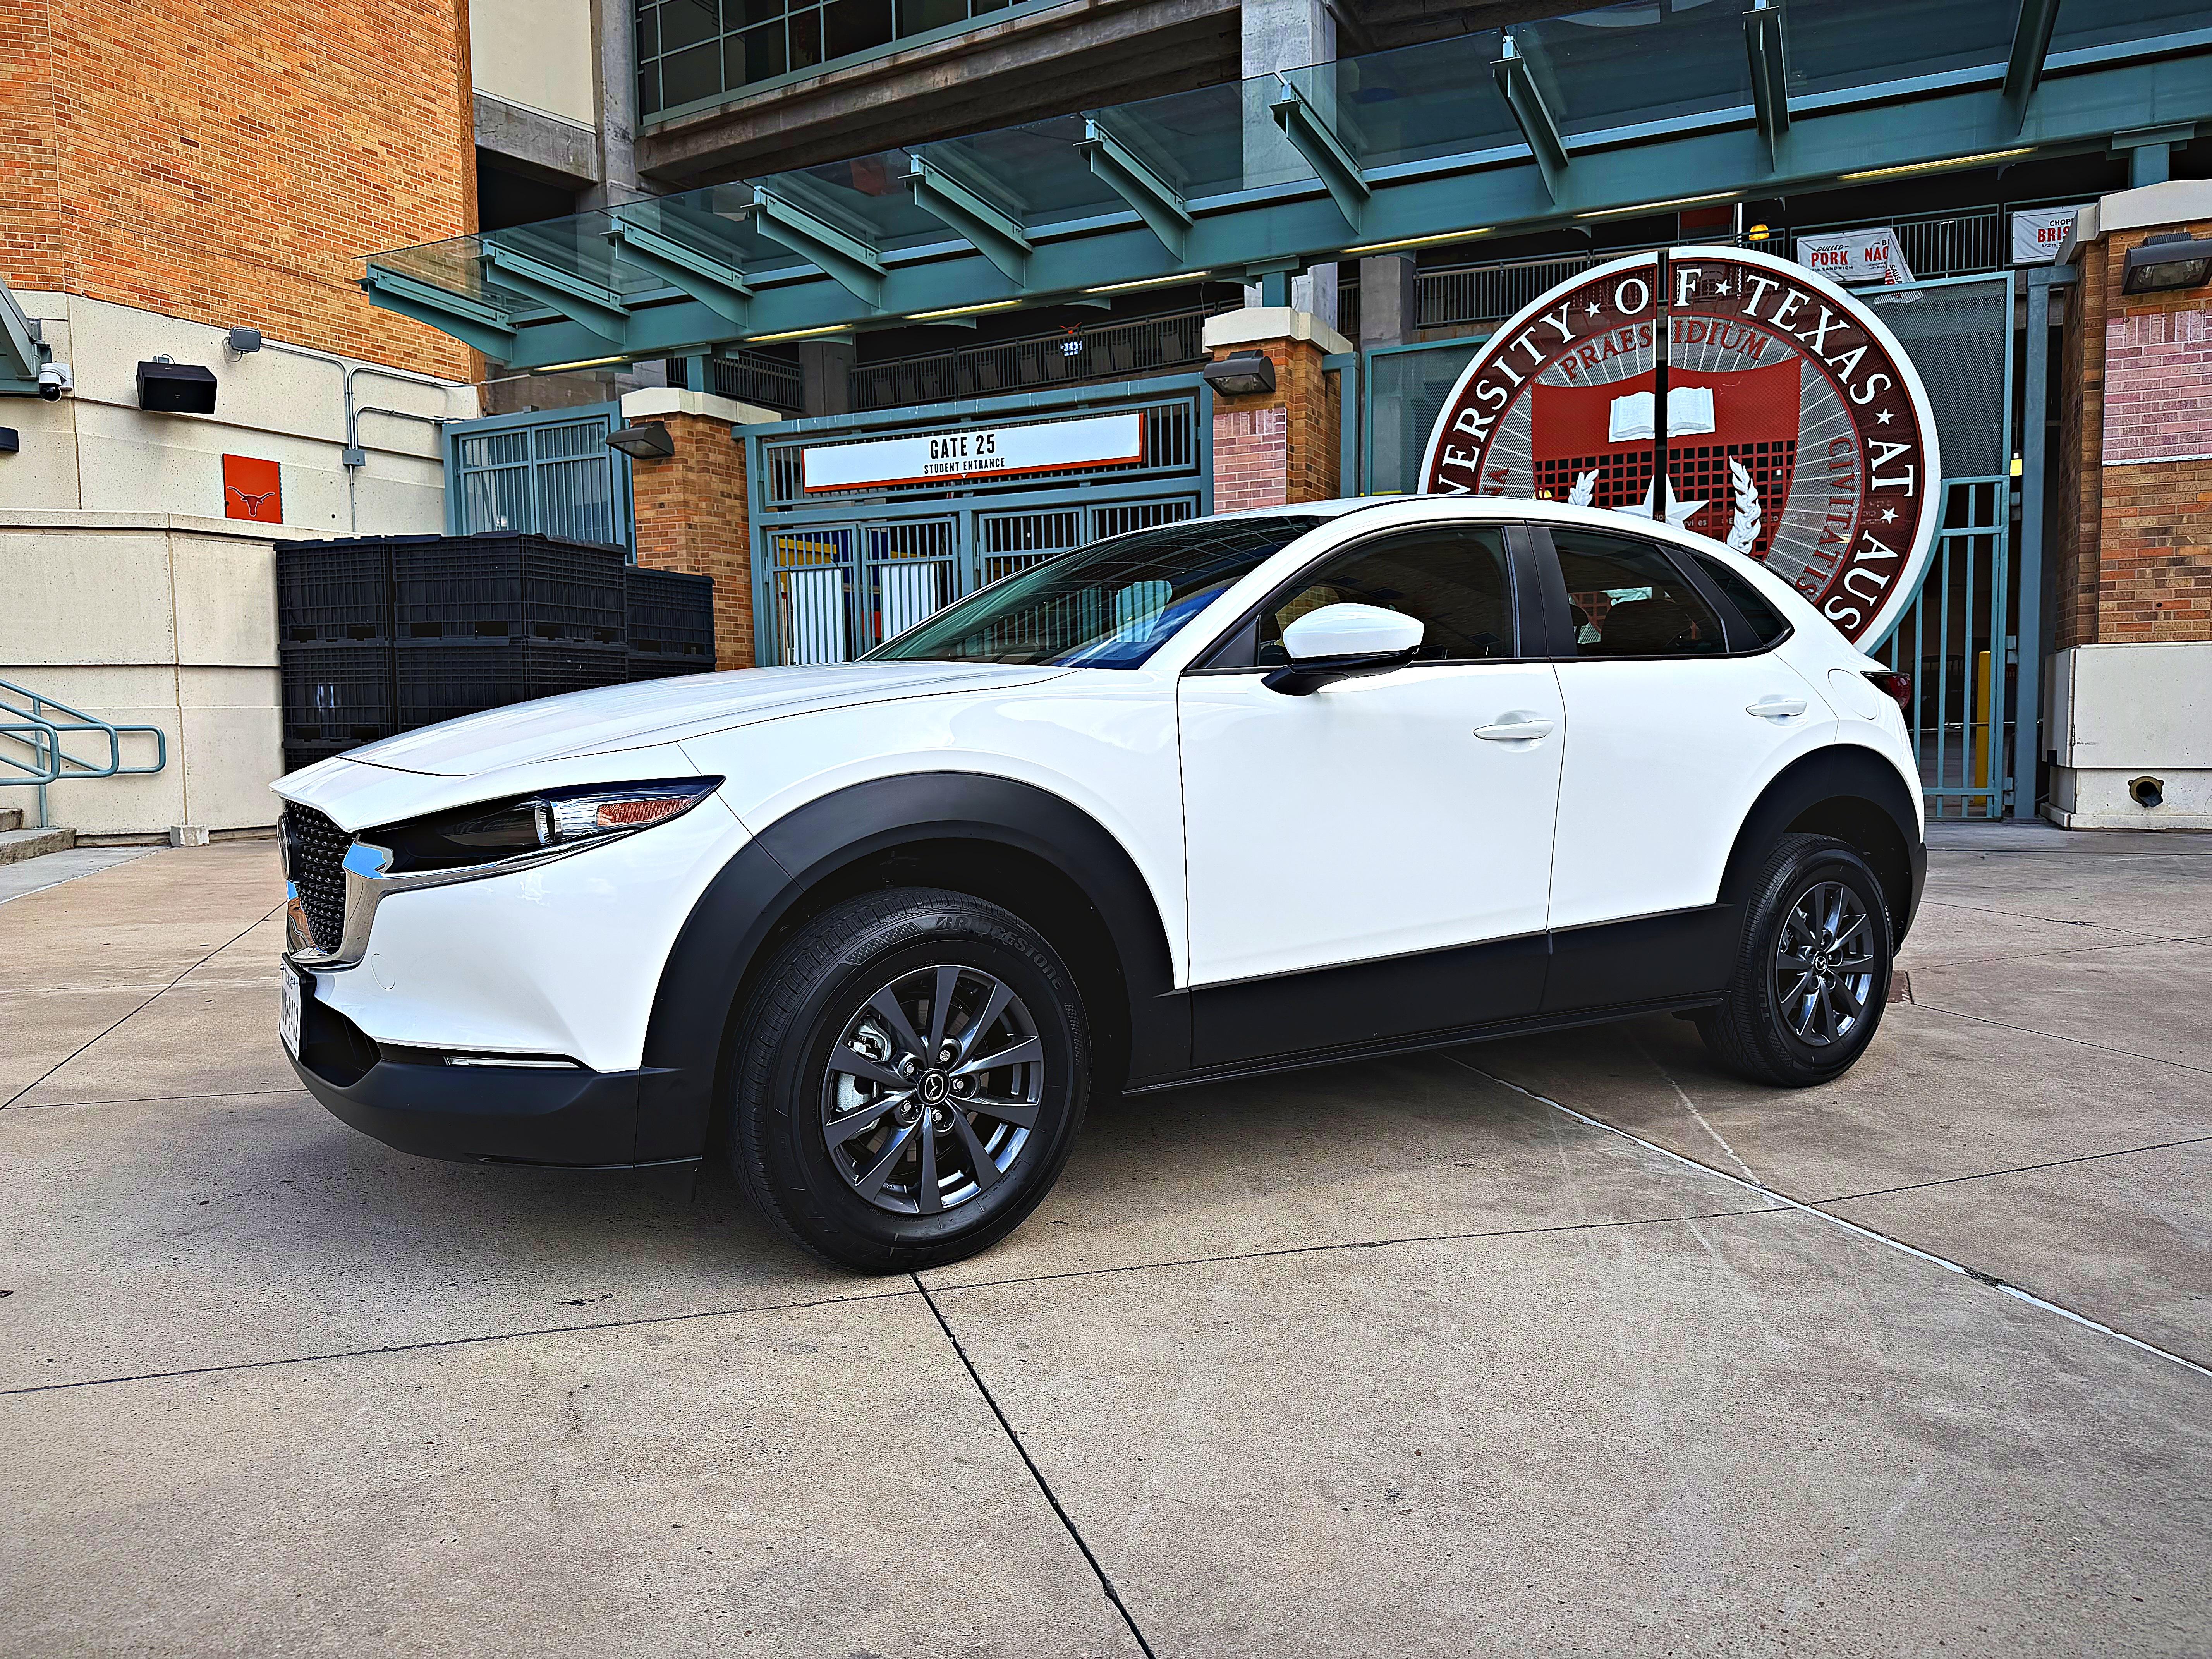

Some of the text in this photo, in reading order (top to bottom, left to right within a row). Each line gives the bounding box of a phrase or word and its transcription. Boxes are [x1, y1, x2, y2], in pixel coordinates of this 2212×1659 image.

[1811, 251, 1848, 267] PORK
[1614, 268, 1702, 315] OF
[1741, 274, 1892, 404] TEXAS
[924, 457, 1005, 474] STUDENT ENTRANCE
[930, 434, 995, 459] GATE 25
[1868, 438, 1914, 497] AT
[1796, 437, 1855, 596] CIVITATIS
[1824, 530, 1898, 630] AUS
[935, 915, 1065, 991] BRIDGESTONE
